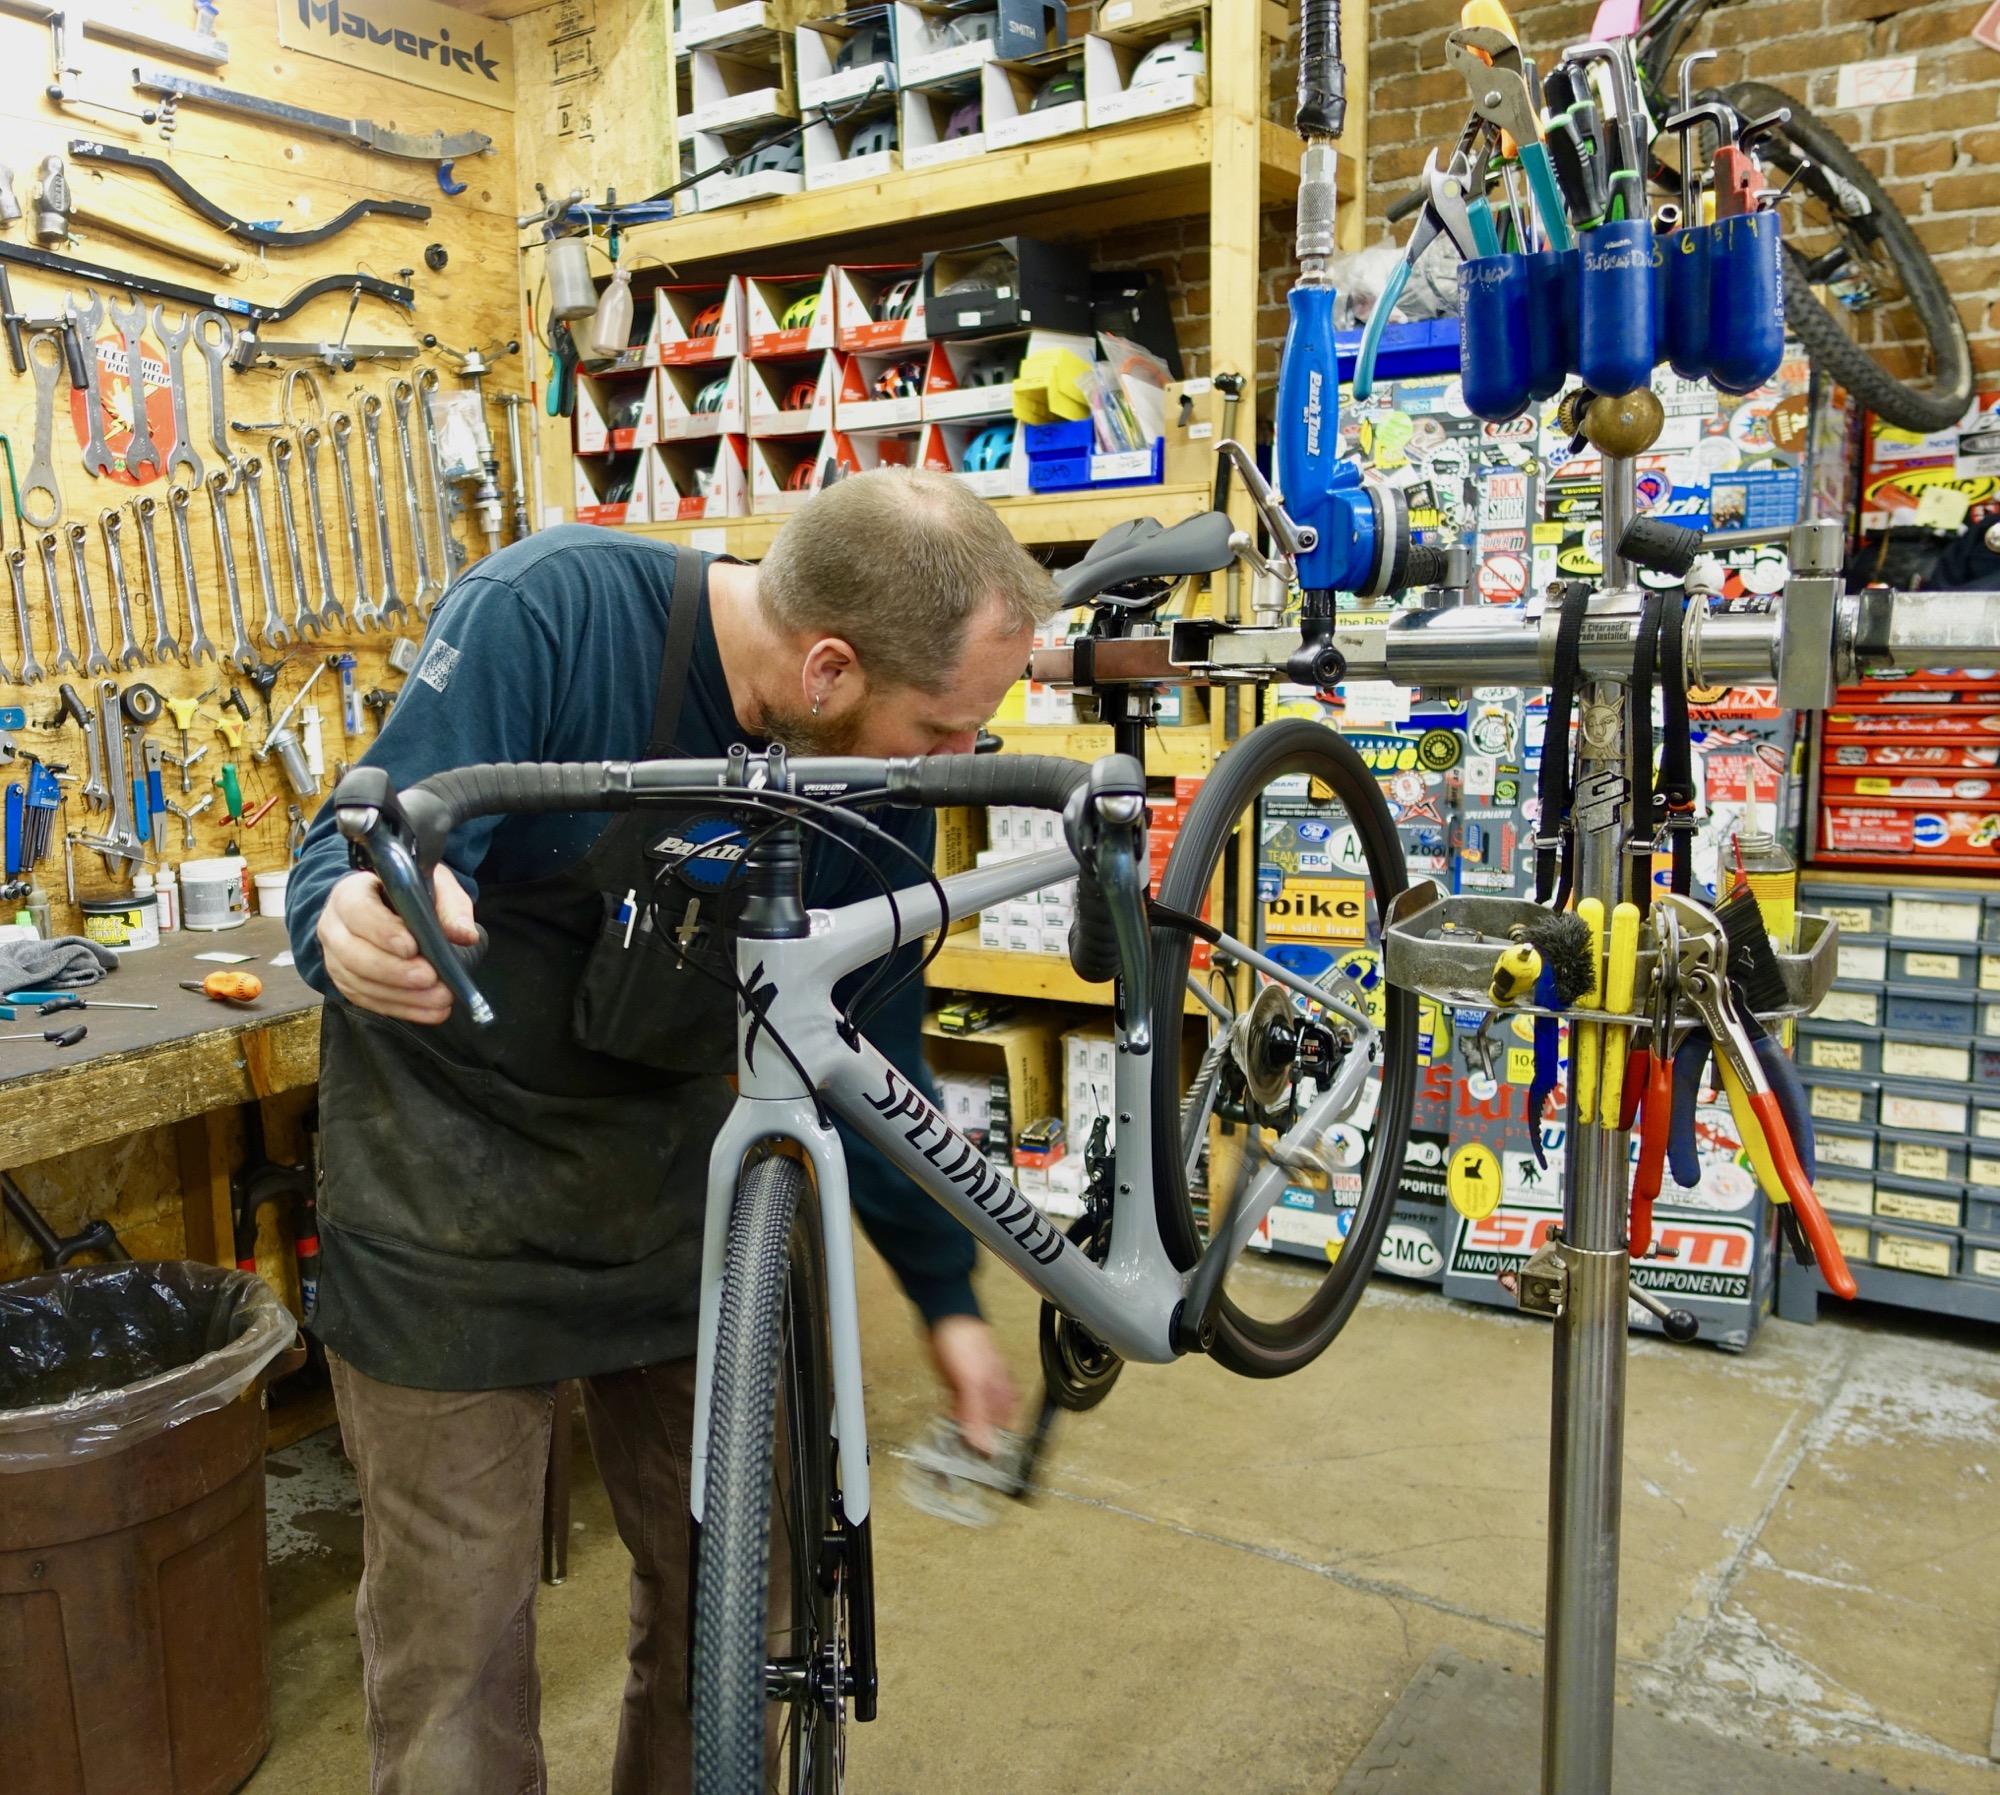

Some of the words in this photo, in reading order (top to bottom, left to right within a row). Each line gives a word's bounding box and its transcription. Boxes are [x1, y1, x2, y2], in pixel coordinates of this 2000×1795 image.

[1008, 20, 1037, 39] SMITH
[298, 0, 500, 83] Maverick
[1680, 233, 1695, 255] 6
[1307, 369, 1323, 457] ParkTool
[1491, 477, 1523, 498] ROCK
[1489, 500, 1525, 520] SHOX
[1482, 570, 1521, 584] CHAIN
[802, 782, 848, 792] SPECIALIZED
[654, 836, 746, 861] ParkTo
[1267, 850, 1299, 864] TEAM
[1301, 853, 1329, 866] EBC
[1268, 893, 1360, 919] bike
[862, 1068, 1066, 1266] SPECIALIZED
[1379, 1234, 1435, 1266] CMC
[1628, 1267, 1748, 1296] COMPONENTS
